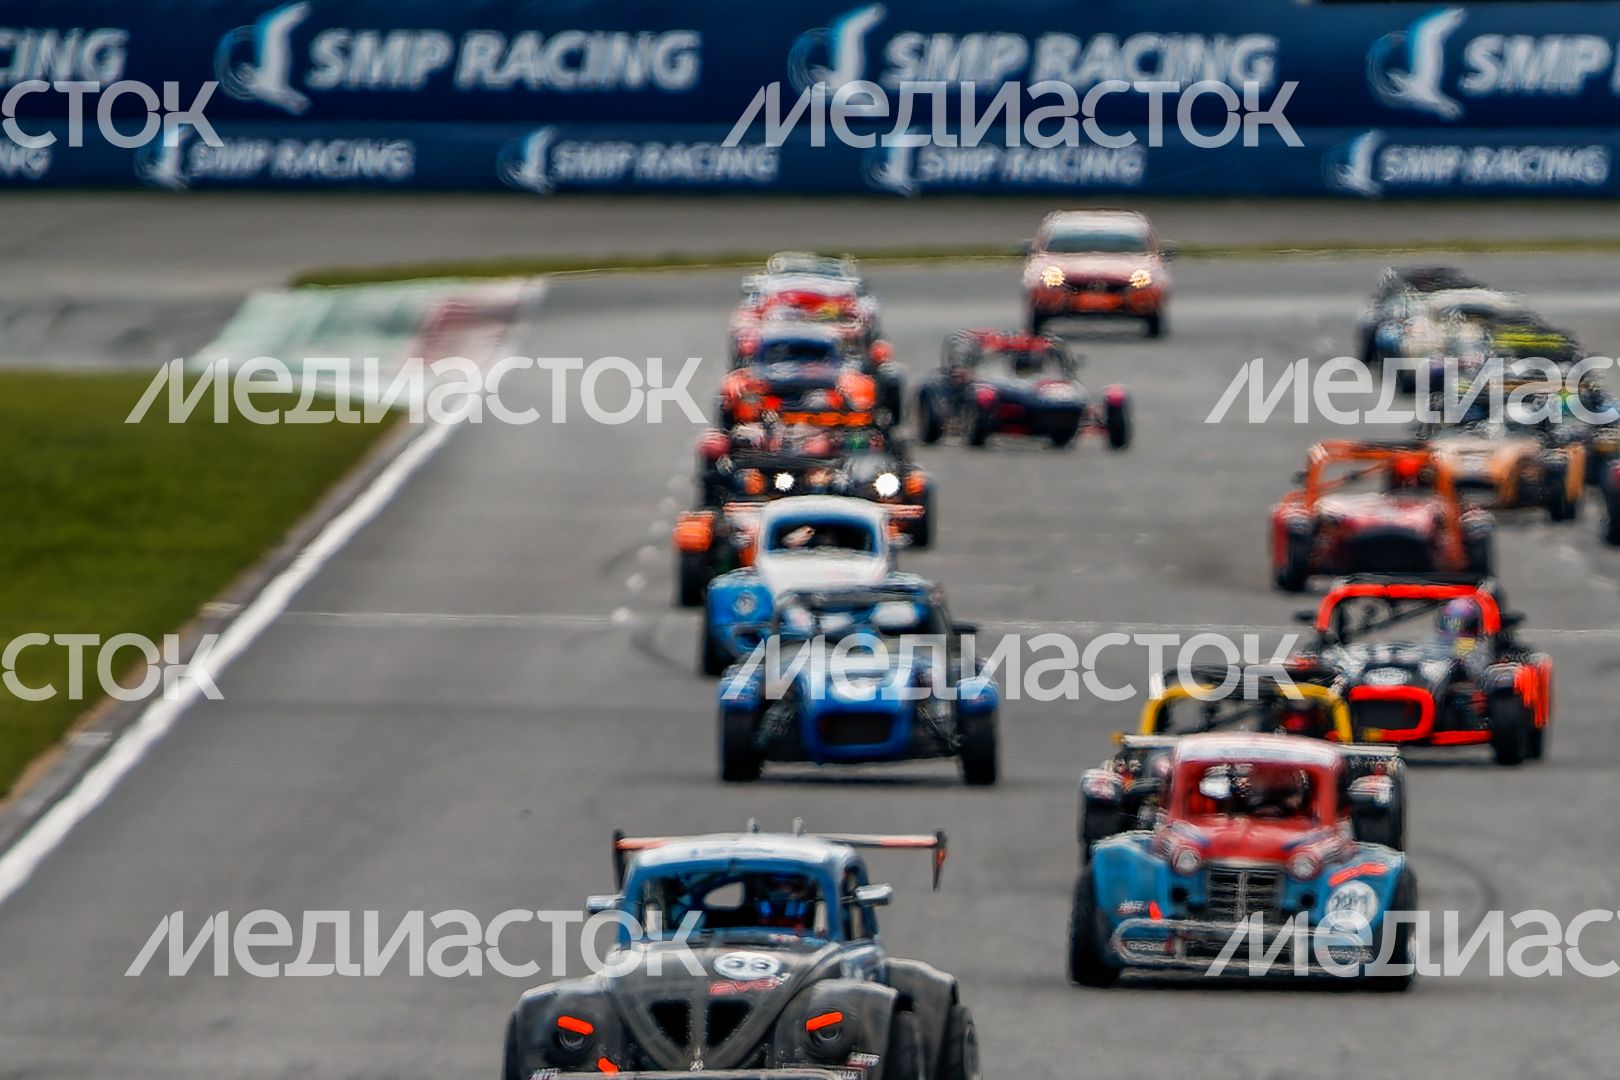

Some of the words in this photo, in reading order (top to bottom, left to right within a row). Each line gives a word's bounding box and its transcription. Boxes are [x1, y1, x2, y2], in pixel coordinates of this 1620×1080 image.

[305, 29, 450, 90] SMP
[455, 29, 702, 92] RACING
[883, 32, 1031, 89] SMP
[1031, 32, 1281, 92] RACING
[1459, 34, 1611, 94] SMP
